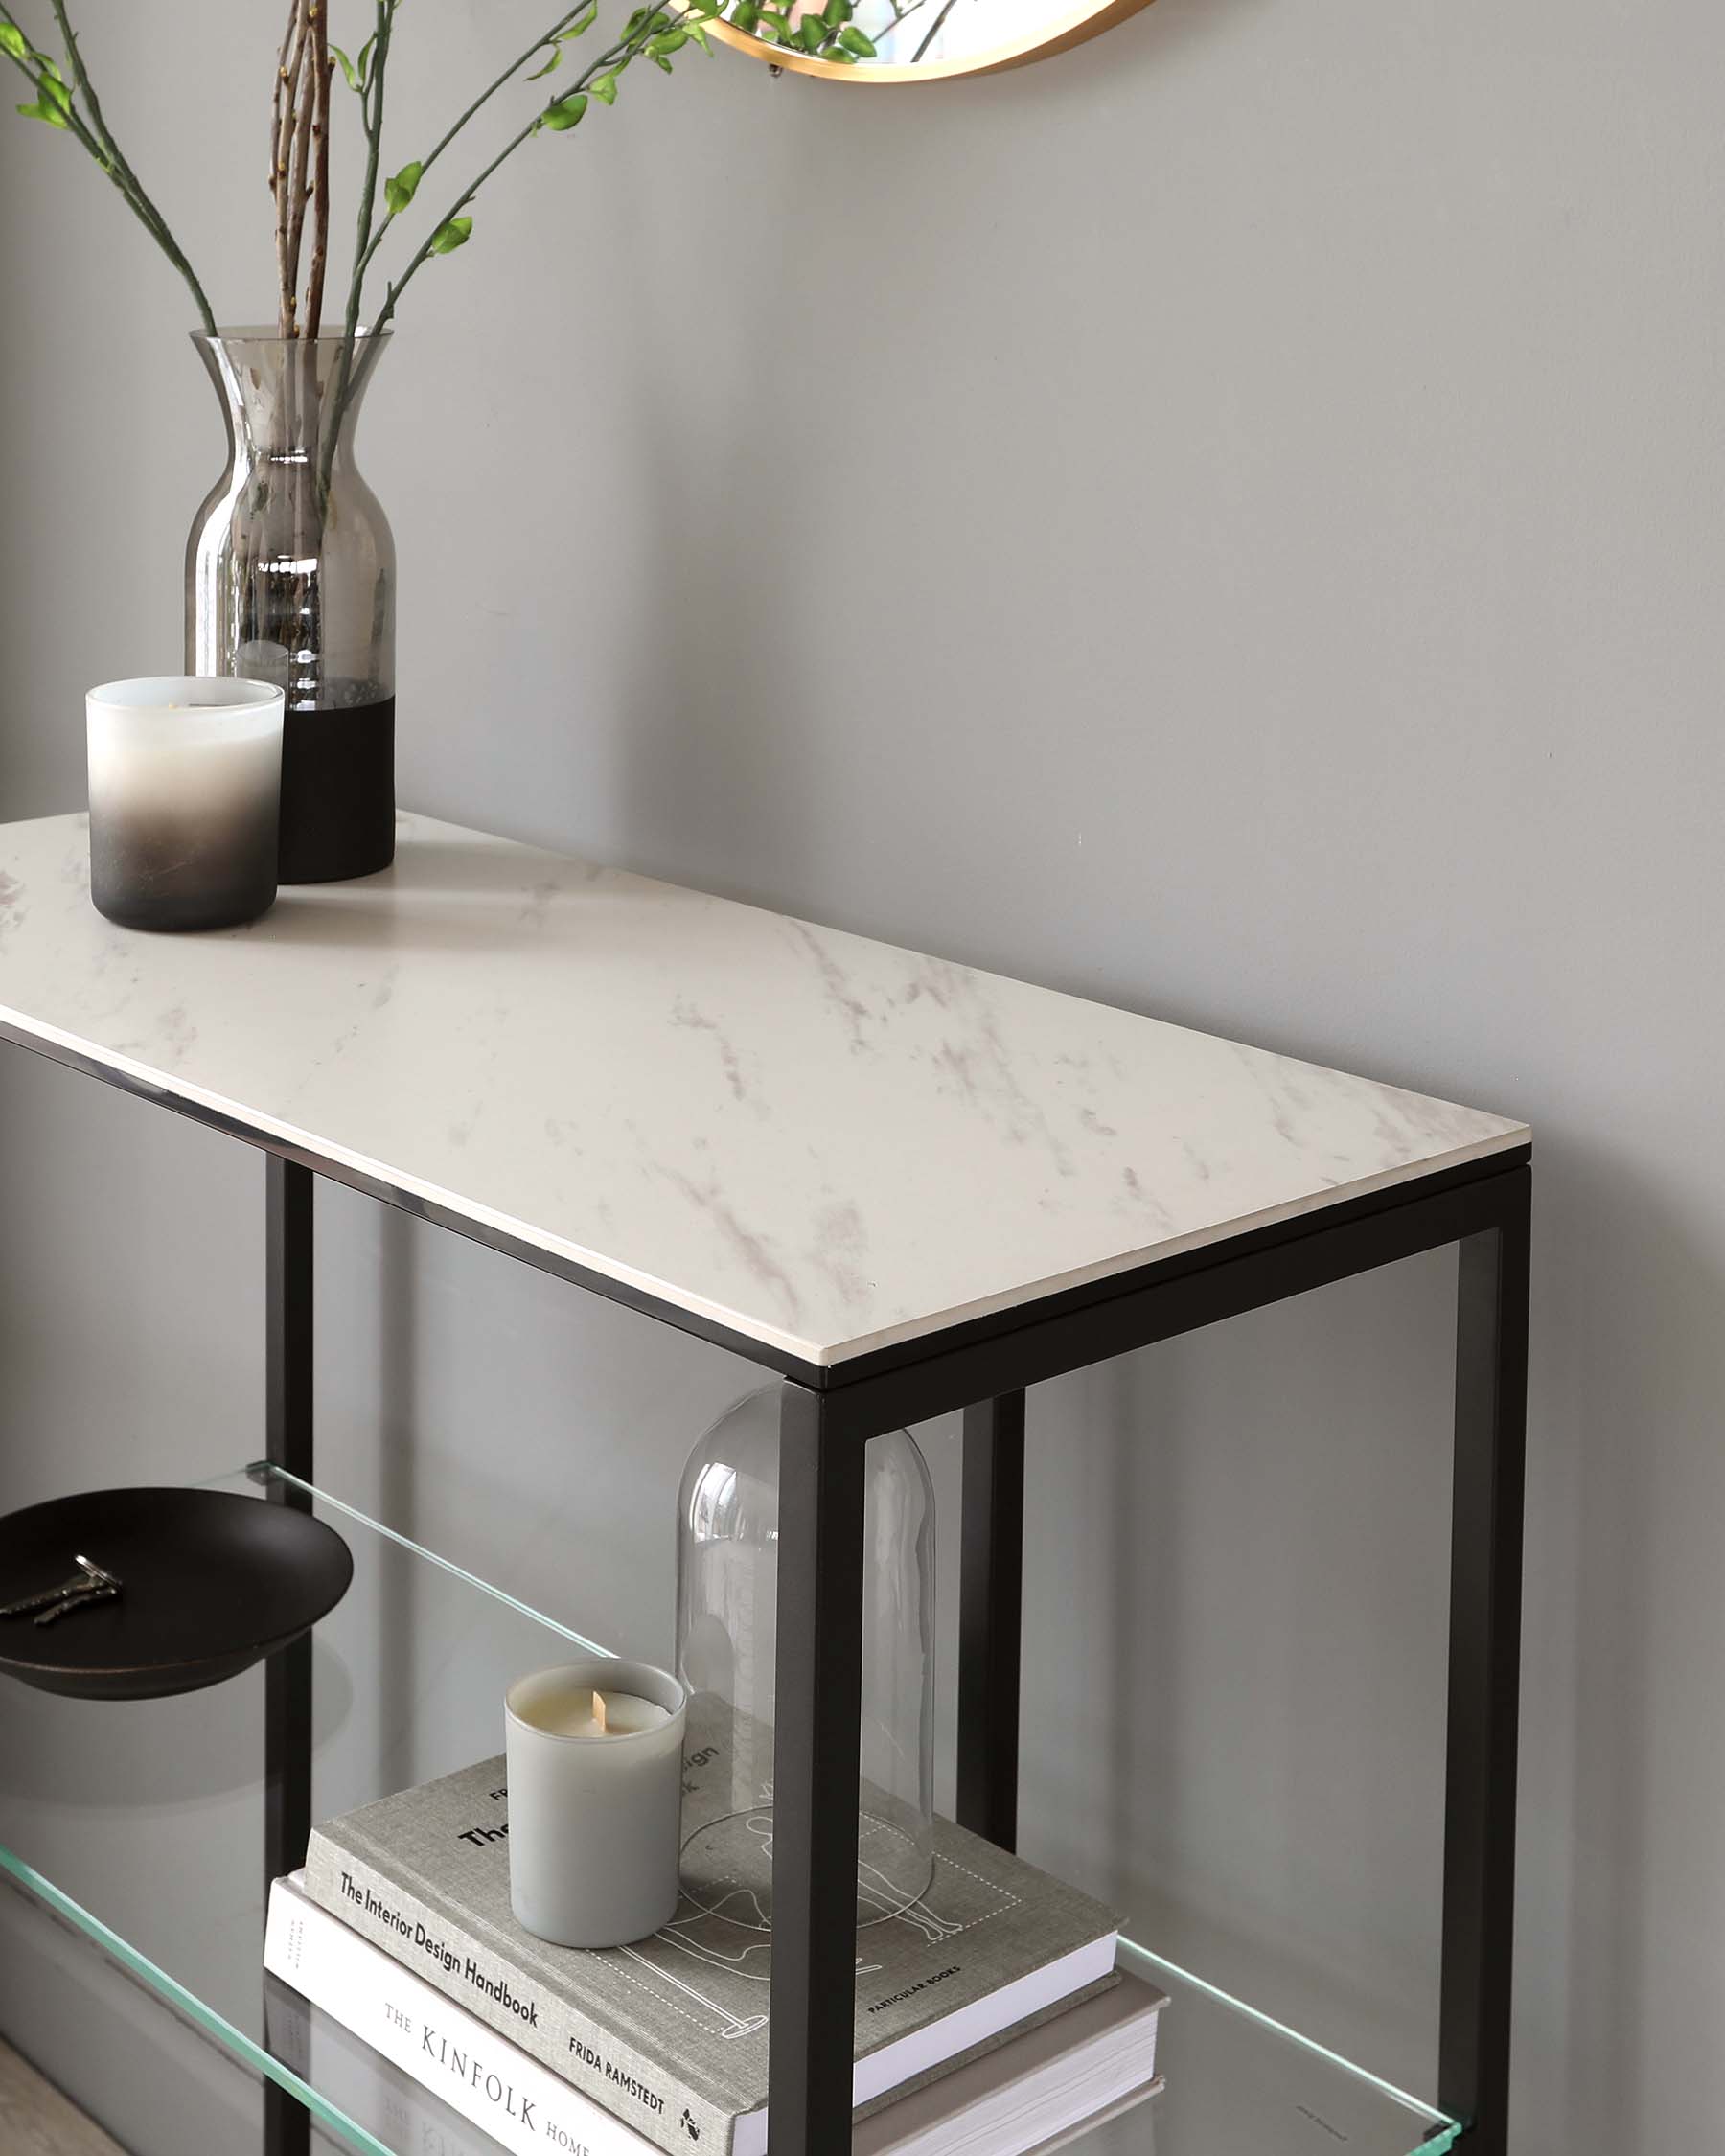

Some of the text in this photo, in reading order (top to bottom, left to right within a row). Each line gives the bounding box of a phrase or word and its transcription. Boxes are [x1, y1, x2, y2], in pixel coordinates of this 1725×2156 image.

[341, 1872, 539, 2029] The Interior Design Handbook
[867, 1965, 961, 2014] PARTICULAR BOOKS
[384, 2002, 412, 2033] THE
[422, 2024, 537, 2132] KINFOLK
[569, 2037, 665, 2115] FRIDA RAMSTEDT
